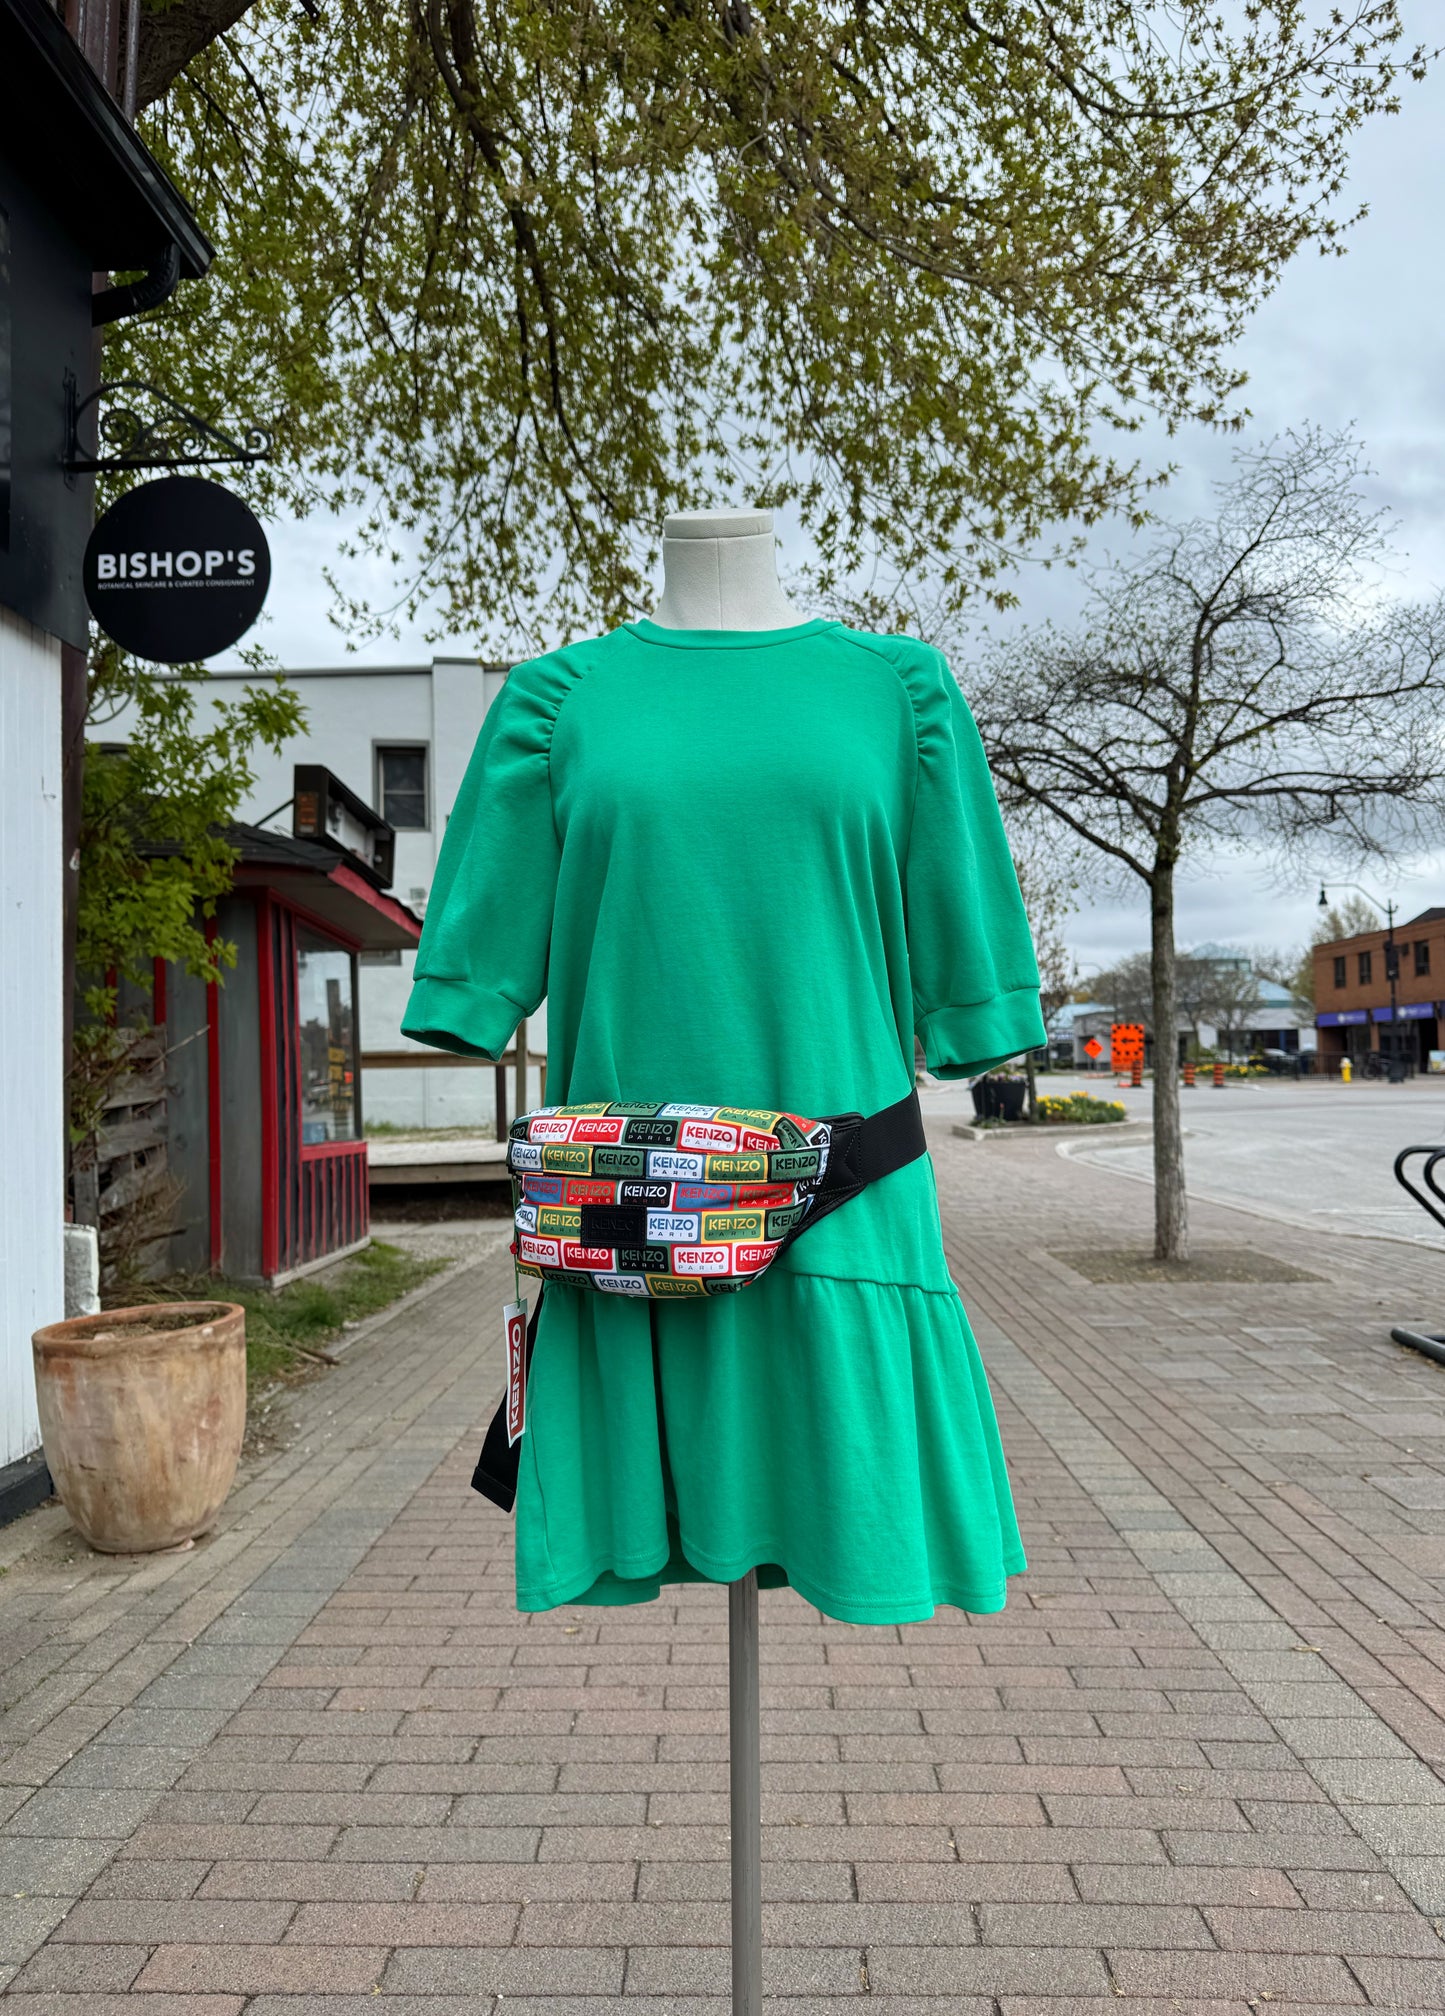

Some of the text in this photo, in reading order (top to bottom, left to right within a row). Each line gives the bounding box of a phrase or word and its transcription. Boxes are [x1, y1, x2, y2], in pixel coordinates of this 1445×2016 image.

[97, 549, 256, 580] BISHOP'S
[98, 582, 134, 590] BOTANICAL
[135, 581, 167, 589] SKINCARE
[175, 580, 204, 588] CURATED
[669, 1104, 713, 1112] KENZO
[725, 1108, 771, 1120] KENZO
[532, 1122, 568, 1134] KENZO
[578, 1122, 618, 1133] KENZO
[629, 1123, 673, 1135] KENZO
[686, 1125, 733, 1142] KENZO
[684, 1139, 731, 1149] PARIS
[512, 1146, 538, 1159] KENZO
[547, 1150, 586, 1163] KENZO
[598, 1153, 640, 1167] KENZO
[653, 1156, 698, 1170] KENZO
[712, 1160, 761, 1172] KENZO
[775, 1155, 817, 1171] KENZO
[652, 1169, 698, 1177] PARIS
[527, 1181, 559, 1194] KENZO
[570, 1185, 611, 1197] KENZO
[624, 1185, 668, 1198] KENZO
[681, 1187, 729, 1200] KENZO
[742, 1187, 790, 1200] KENZO
[543, 1213, 581, 1227] KENZO
[649, 1218, 694, 1231] KENZO
[708, 1217, 757, 1230] KENZO
[522, 1239, 555, 1256] KENZO
[567, 1246, 609, 1260] KENZO
[621, 1249, 665, 1262] KENZO
[678, 1251, 725, 1264] KENZO
[547, 1273, 587, 1285] KENZO
[598, 1278, 642, 1289] KENZO
[653, 1280, 698, 1293] KENZO
[511, 1323, 522, 1429] KENZO
